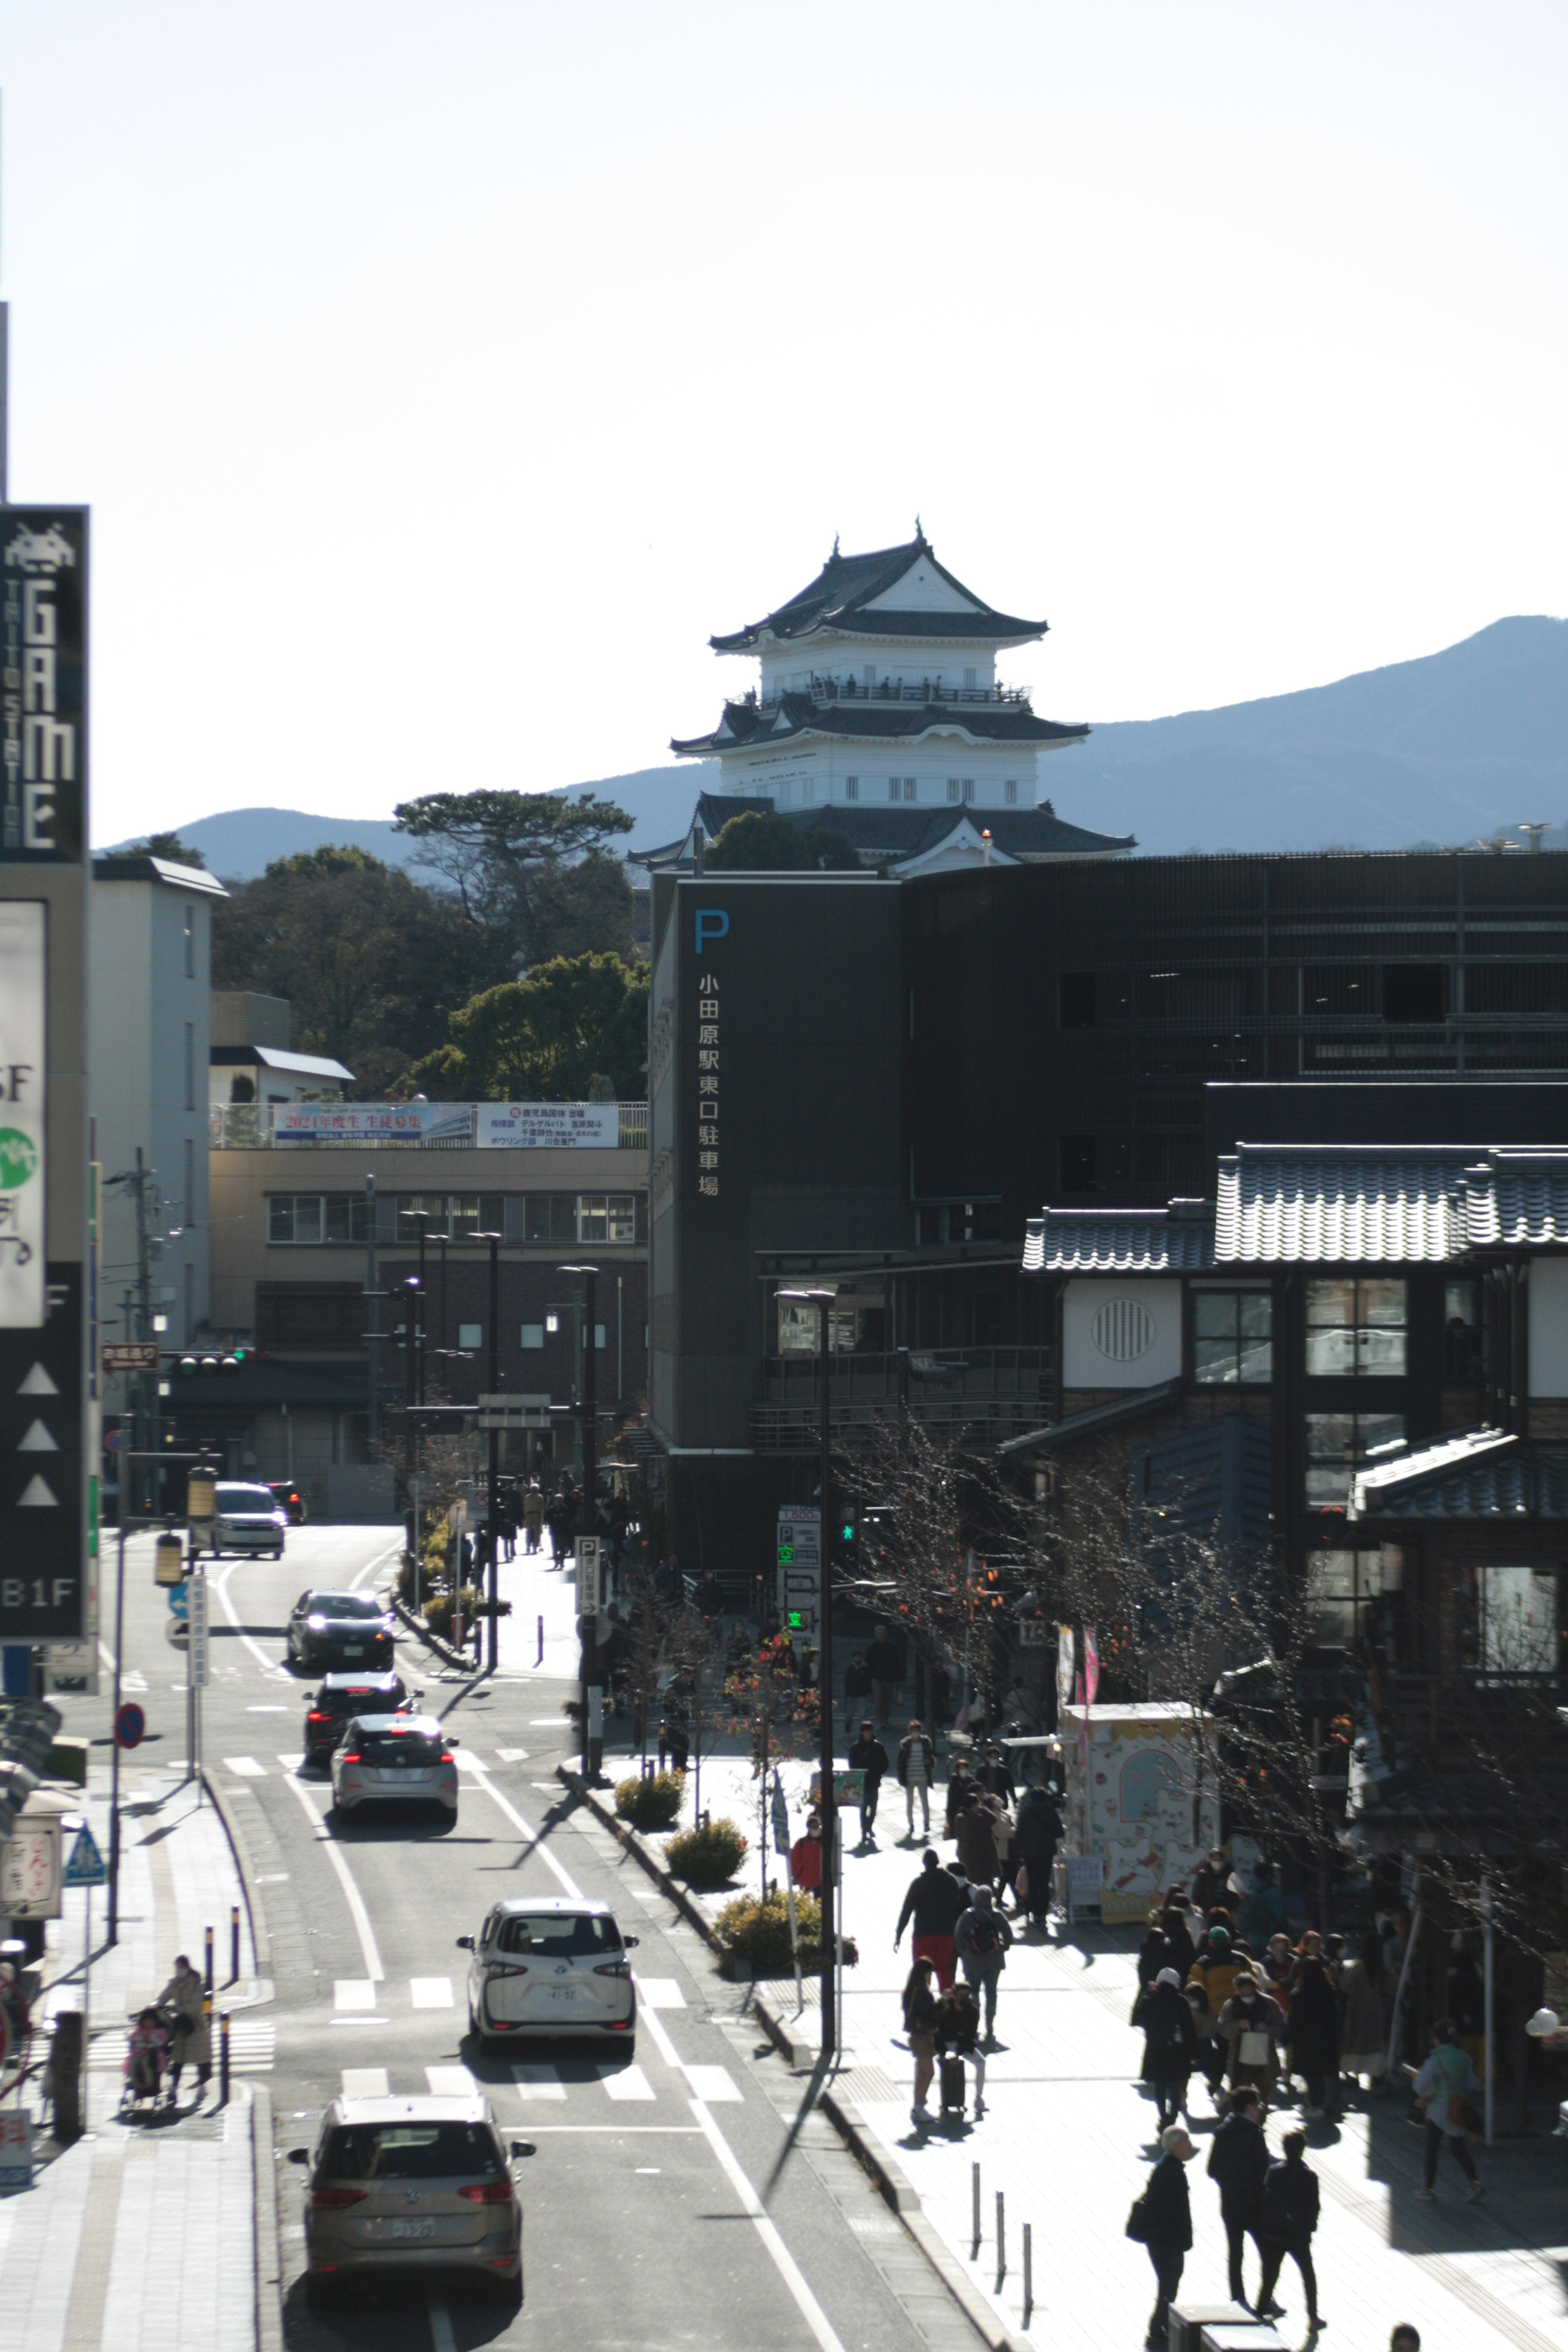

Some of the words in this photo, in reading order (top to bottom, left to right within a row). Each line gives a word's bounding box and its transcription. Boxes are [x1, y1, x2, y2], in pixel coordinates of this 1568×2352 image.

[23, 579, 75, 849] GAME
[695, 909, 730, 955] P
[699, 974, 719, 1196] 小田原駅東口駐車場
[285, 1115, 359, 1129] 2024年度生
[366, 1114, 422, 1129] 生徒募集
[491, 1120, 515, 1128] 相撲部
[523, 1109, 566, 1118] 鹿児島国体
[569, 1109, 585, 1118] 出場
[778, 1545, 793, 1563] 空
[2, 1578, 76, 1607] B1F
[585, 1557, 595, 1601] 東口駐車場
